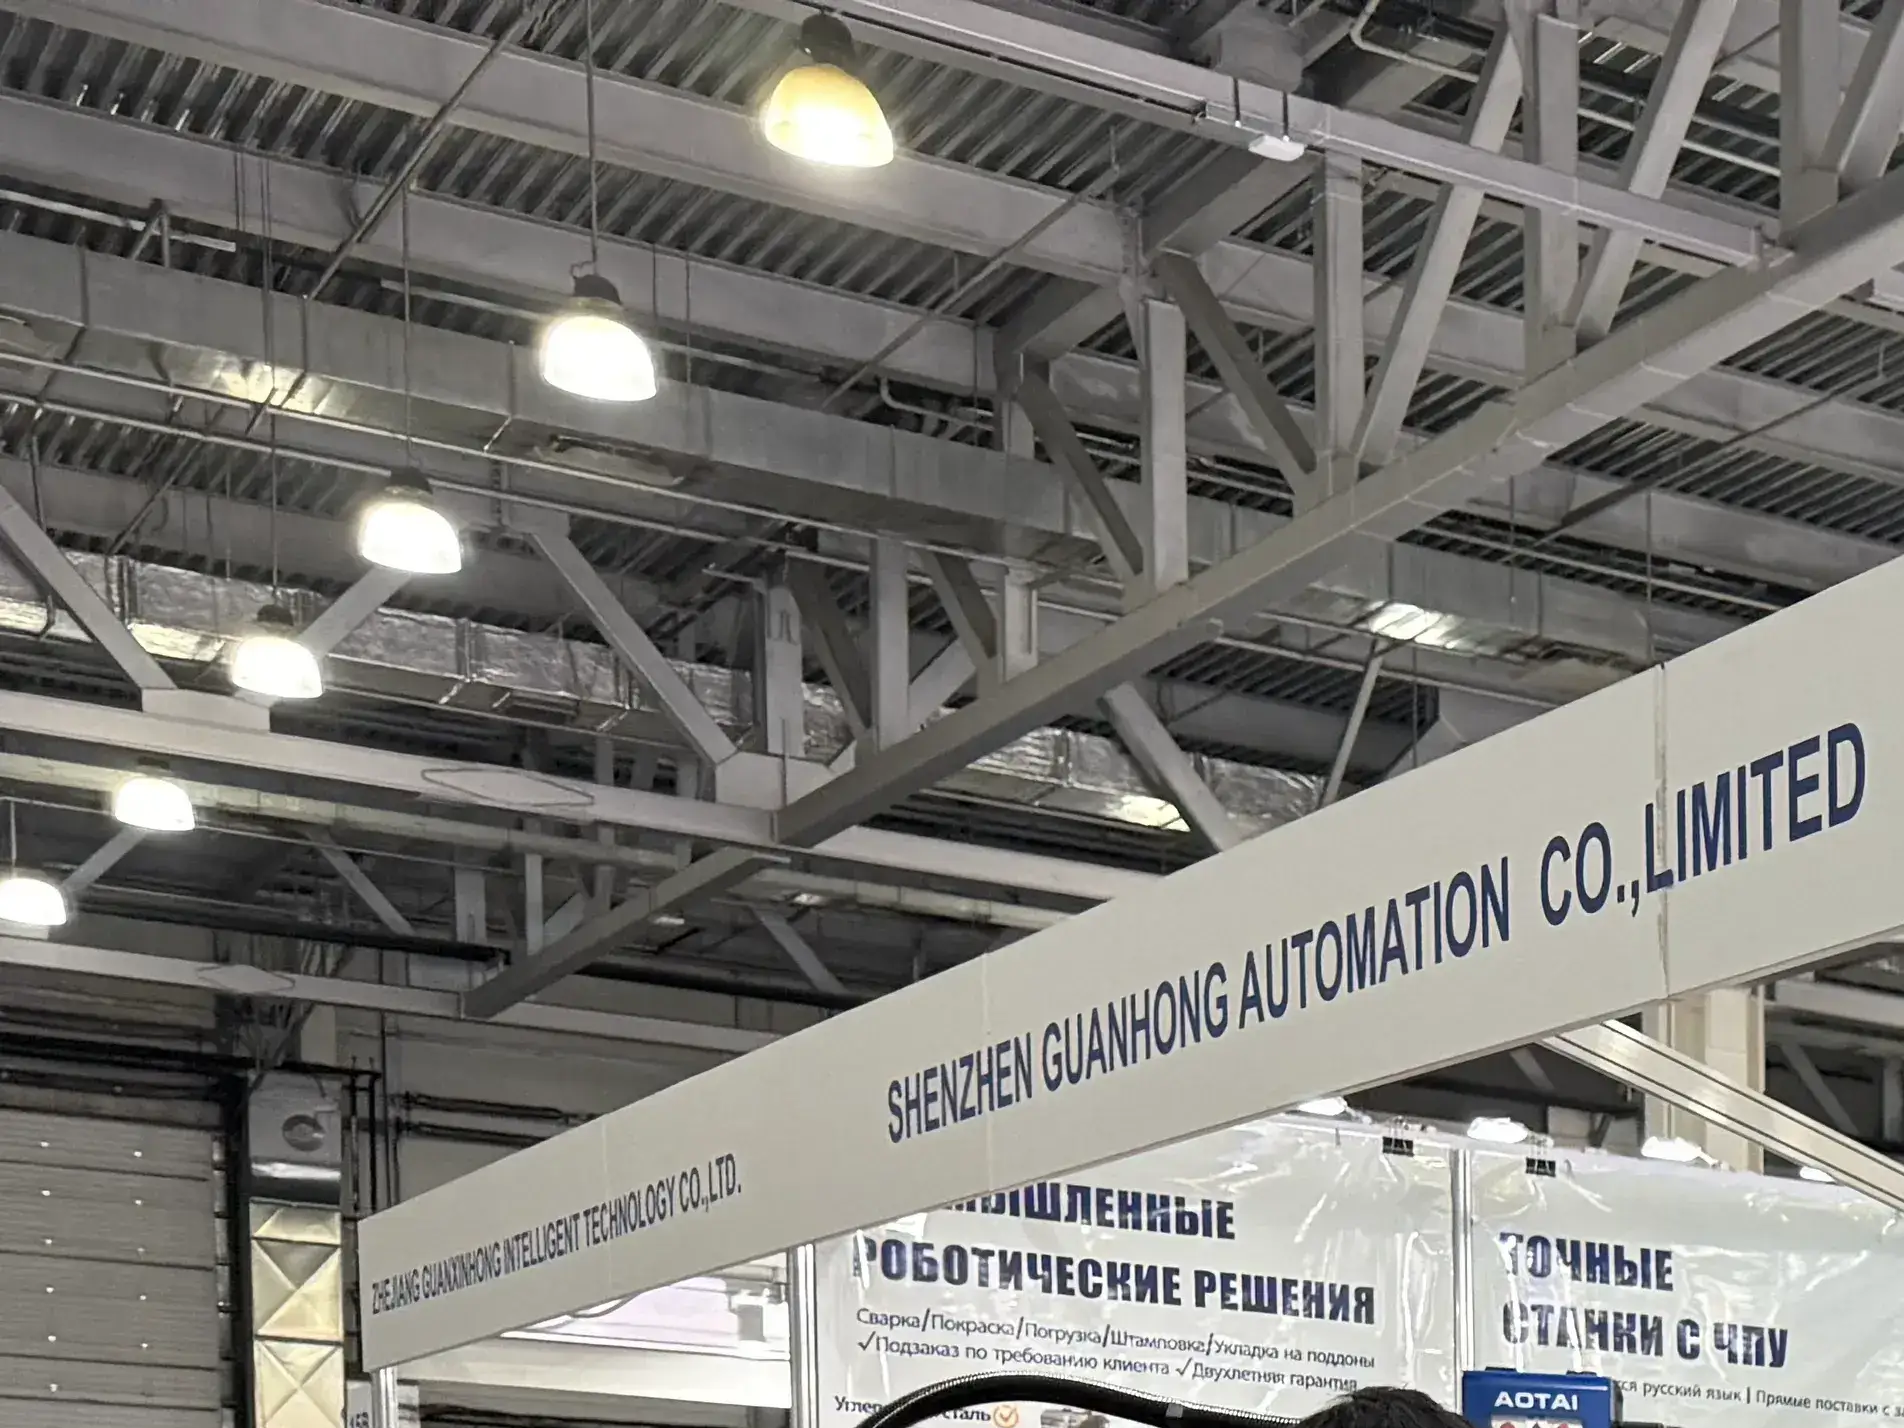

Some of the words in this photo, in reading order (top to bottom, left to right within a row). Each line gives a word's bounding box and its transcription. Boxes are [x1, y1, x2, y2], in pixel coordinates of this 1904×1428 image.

[887, 1037, 1034, 1145] SHENZHEN
[1041, 960, 1229, 1092] GUANHONG
[1238, 856, 1511, 1031] AUTOMATION
[1538, 722, 1867, 926] CO.,LIMITED
[939, 1181, 1236, 1241] ЫШЛЕННЫЕ
[371, 1268, 421, 1315] ZHEJIANG
[421, 1240, 502, 1300] GUANXINHONG
[503, 1212, 581, 1275] INTELLIGENT
[583, 1175, 677, 1247] TECHNOLOGY
[852, 1235, 1182, 1307] РОБОТИЧЕСКИЕ
[1193, 1268, 1376, 1325] РЕШЕНИЯ
[966, 1346, 988, 1360] по
[993, 1348, 1098, 1370] требованию
[1103, 1357, 1170, 1374] клиента
[1284, 1347, 1302, 1361] на
[1307, 1350, 1375, 1369] поддоны
[1502, 1298, 1665, 1358] СТАНКИ
[1713, 1324, 1789, 1368] ЧПУ
[1494, 1391, 1578, 1411] AOTAI
[1643, 1382, 1701, 1399] русский
[1705, 1389, 1742, 1402] язык
[1815, 1399, 1879, 1415] поставки
